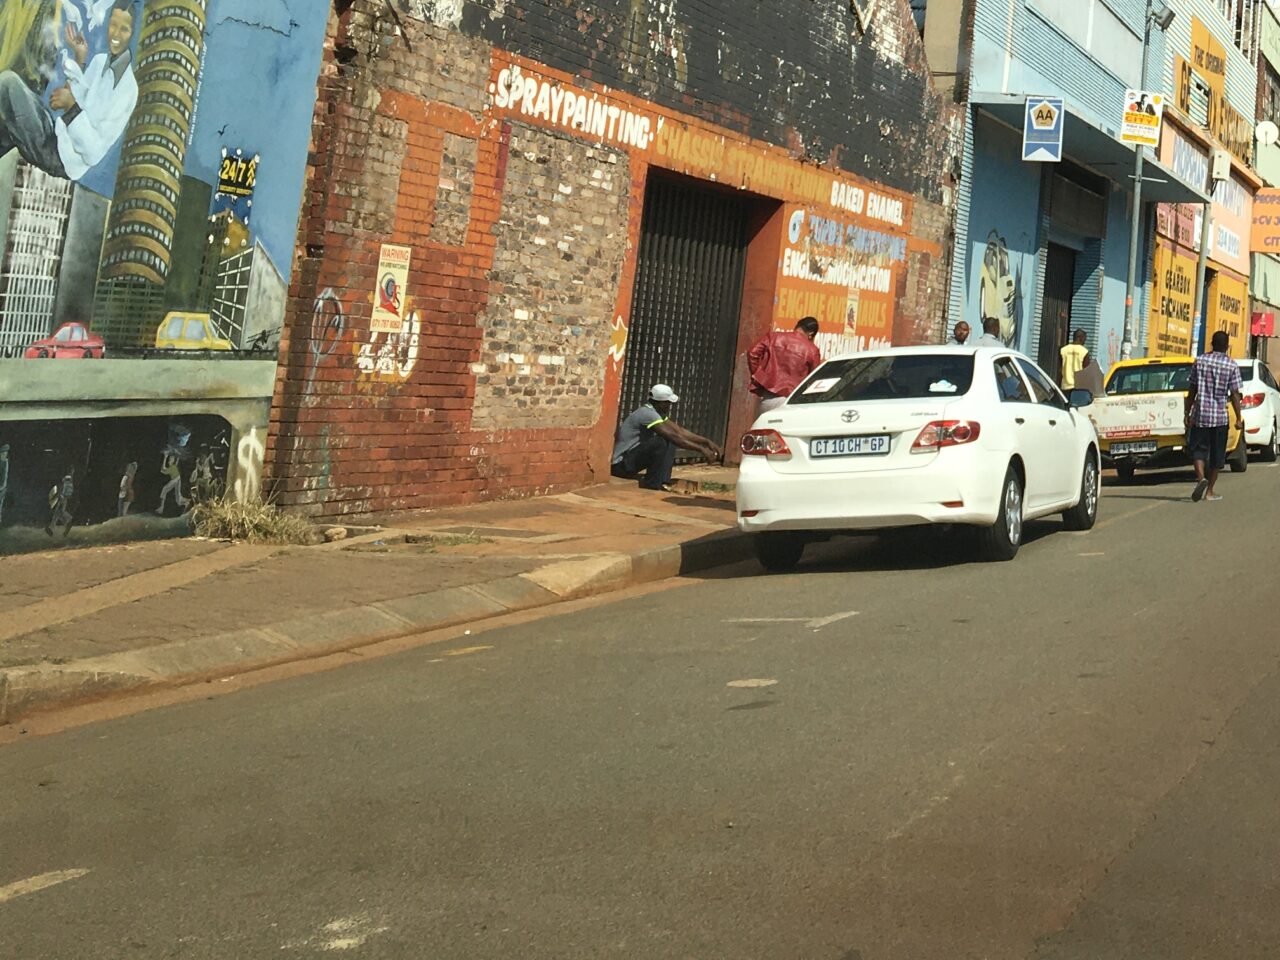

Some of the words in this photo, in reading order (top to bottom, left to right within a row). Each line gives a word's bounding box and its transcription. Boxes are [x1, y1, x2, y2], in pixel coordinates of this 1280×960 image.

[1194, 45, 1205, 68] THE
[1036, 109, 1053, 121] AA
[494, 68, 650, 150] SPRAYPAINTING
[656, 122, 725, 171] CHASSIS
[830, 180, 864, 215] BAKED
[866, 191, 903, 226] ENAMEL
[381, 248, 410, 261] WARNING
[1166, 269, 1191, 296] GEARBOX
[779, 288, 827, 320] ENGINE
[827, 295, 887, 328] OVEAULS
[1161, 296, 1190, 322] EXCHANGE
[816, 441, 829, 454] CT
[832, 440, 844, 453] 10
[848, 439, 861, 452] CH
[870, 438, 884, 451] GP
